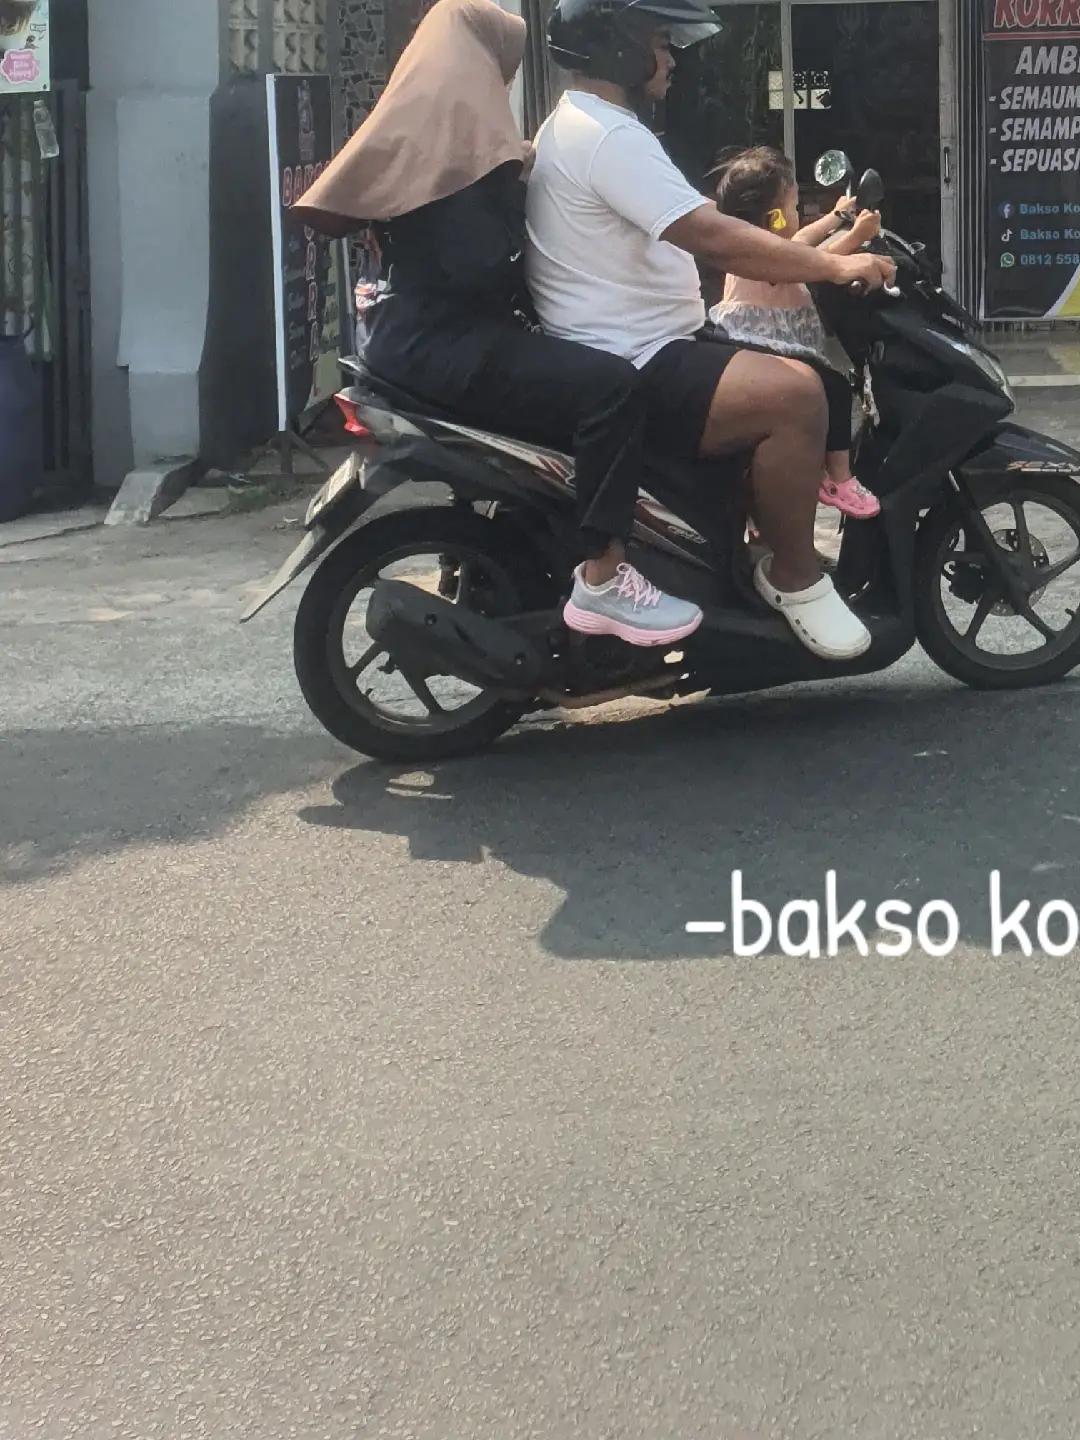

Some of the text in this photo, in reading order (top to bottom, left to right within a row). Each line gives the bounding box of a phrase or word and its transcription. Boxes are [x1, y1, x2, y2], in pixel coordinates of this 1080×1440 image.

[1020, 203, 1060, 215] Bakso
[1020, 229, 1060, 240] Bakso
[1020, 254, 1052, 265] 0812
